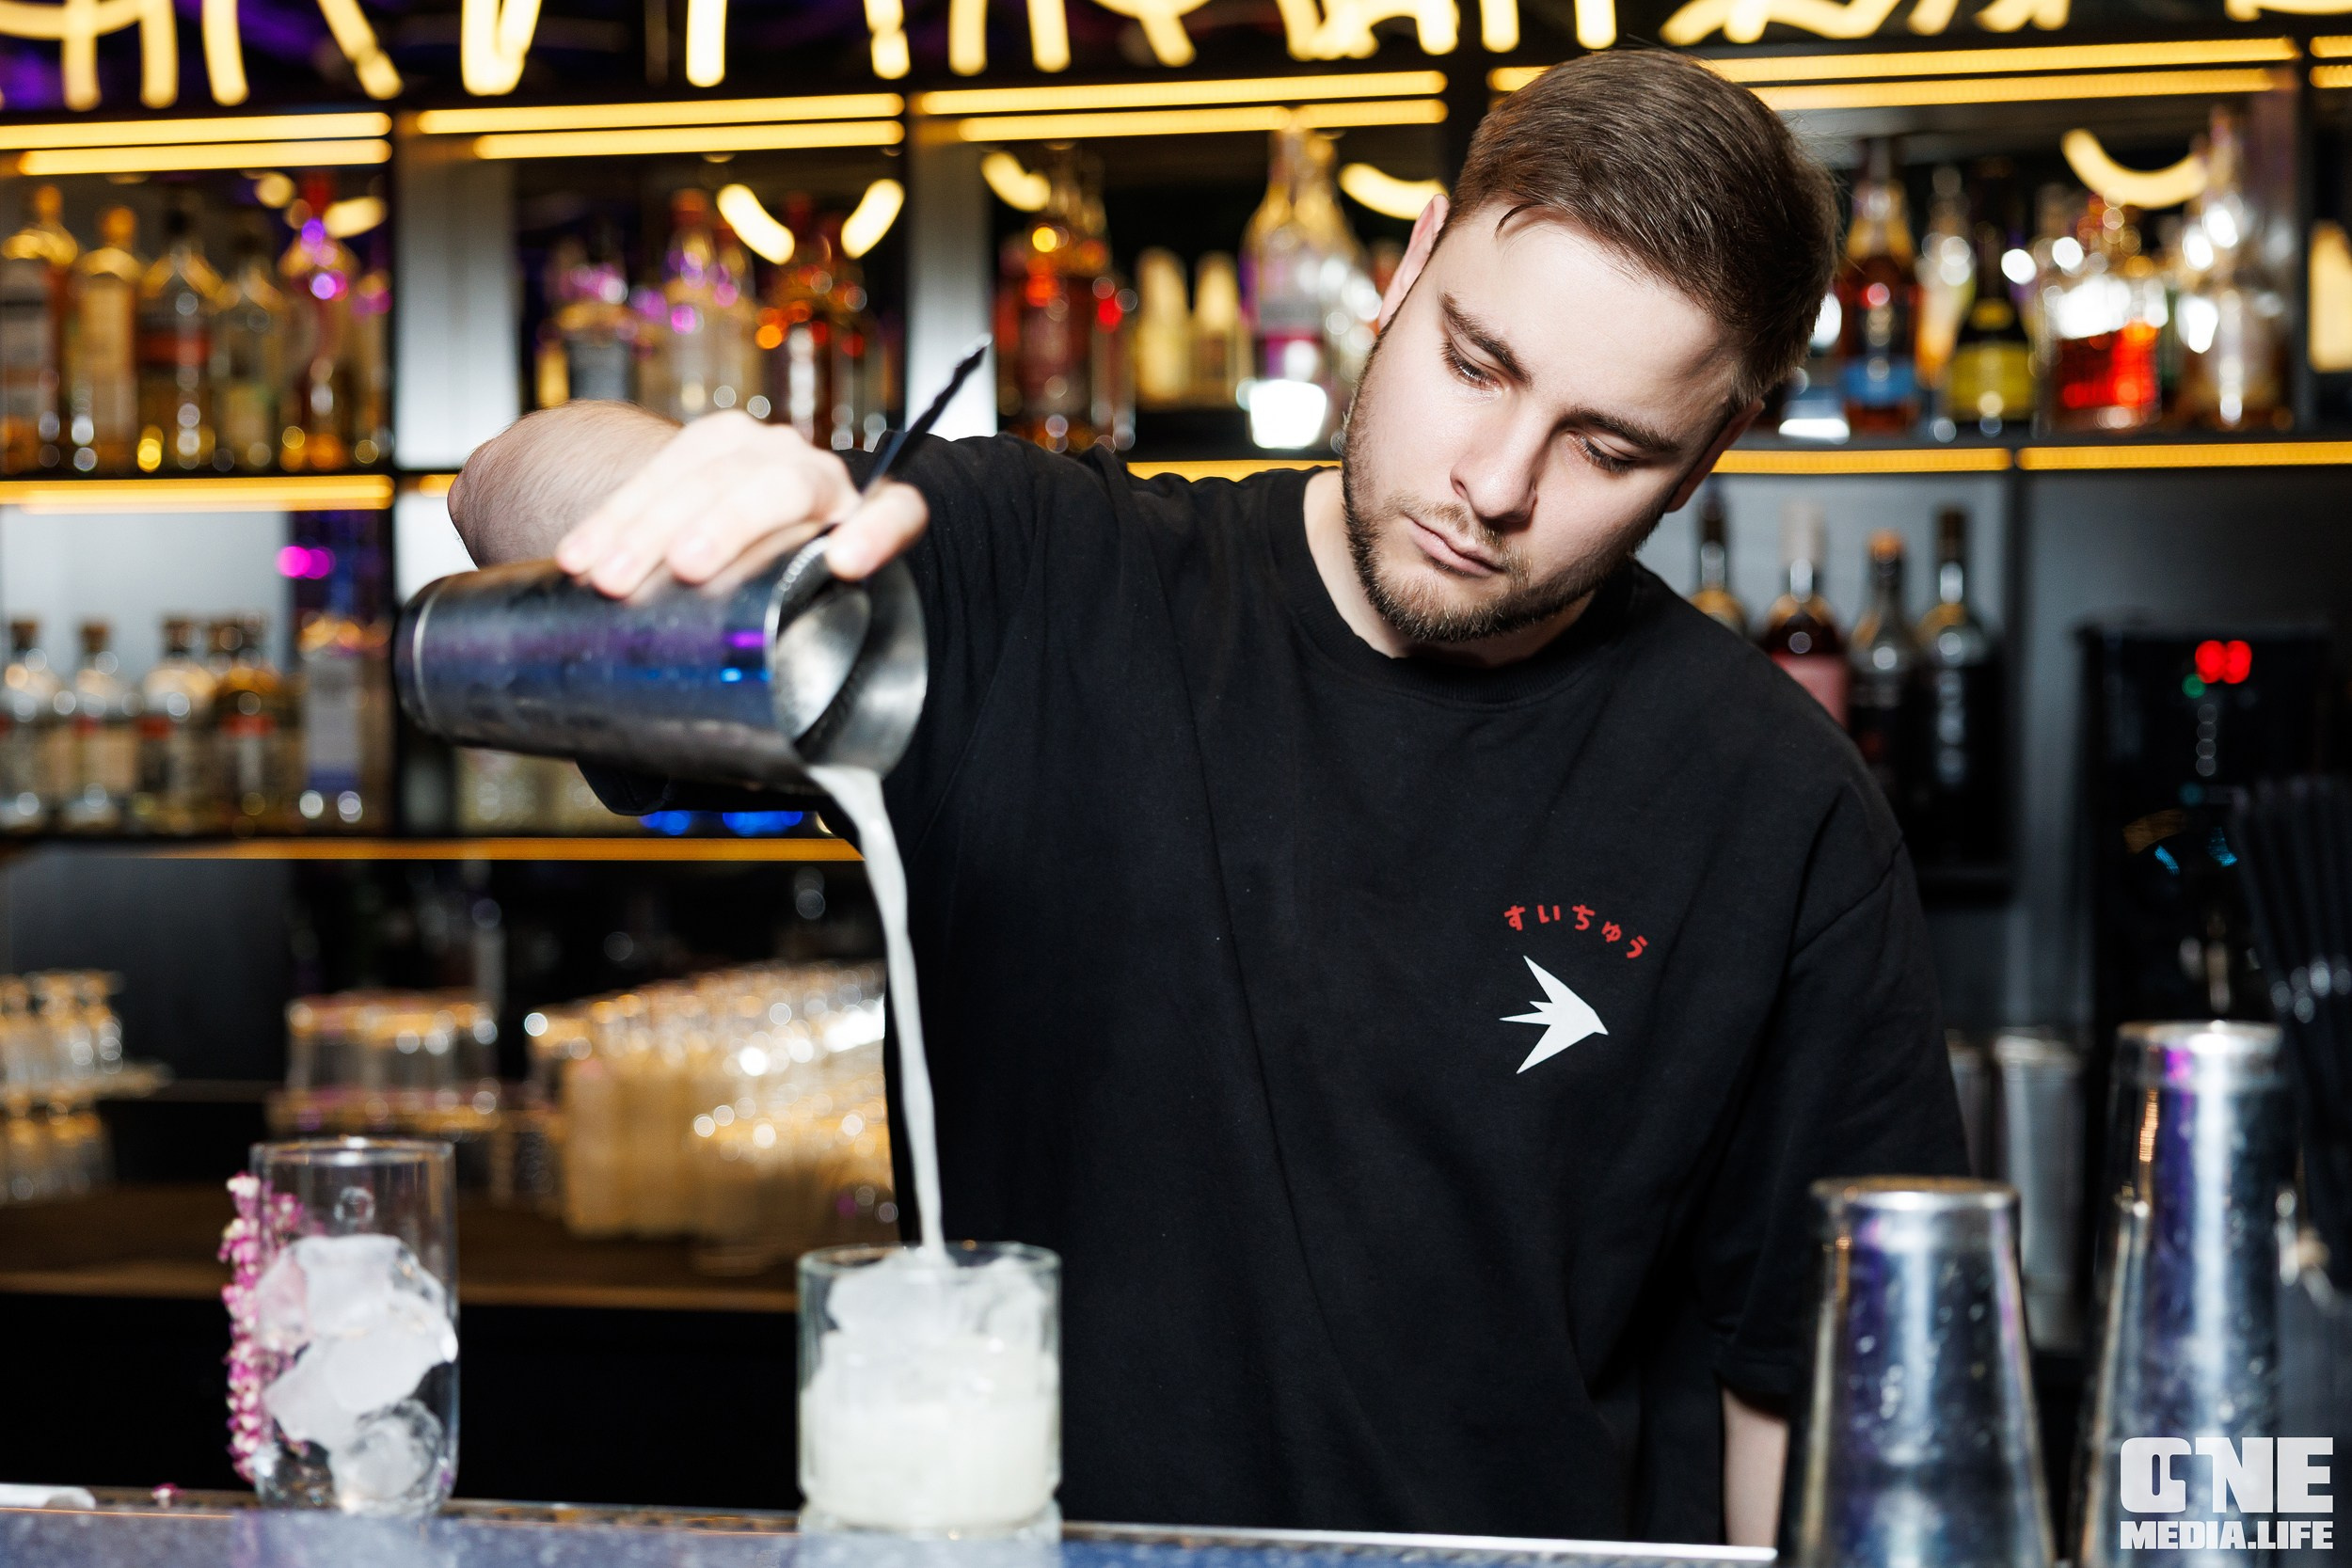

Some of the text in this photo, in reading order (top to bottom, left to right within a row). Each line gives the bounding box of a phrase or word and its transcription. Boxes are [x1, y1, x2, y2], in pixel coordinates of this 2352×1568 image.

[1503, 904, 1648, 958] すいちゅう
